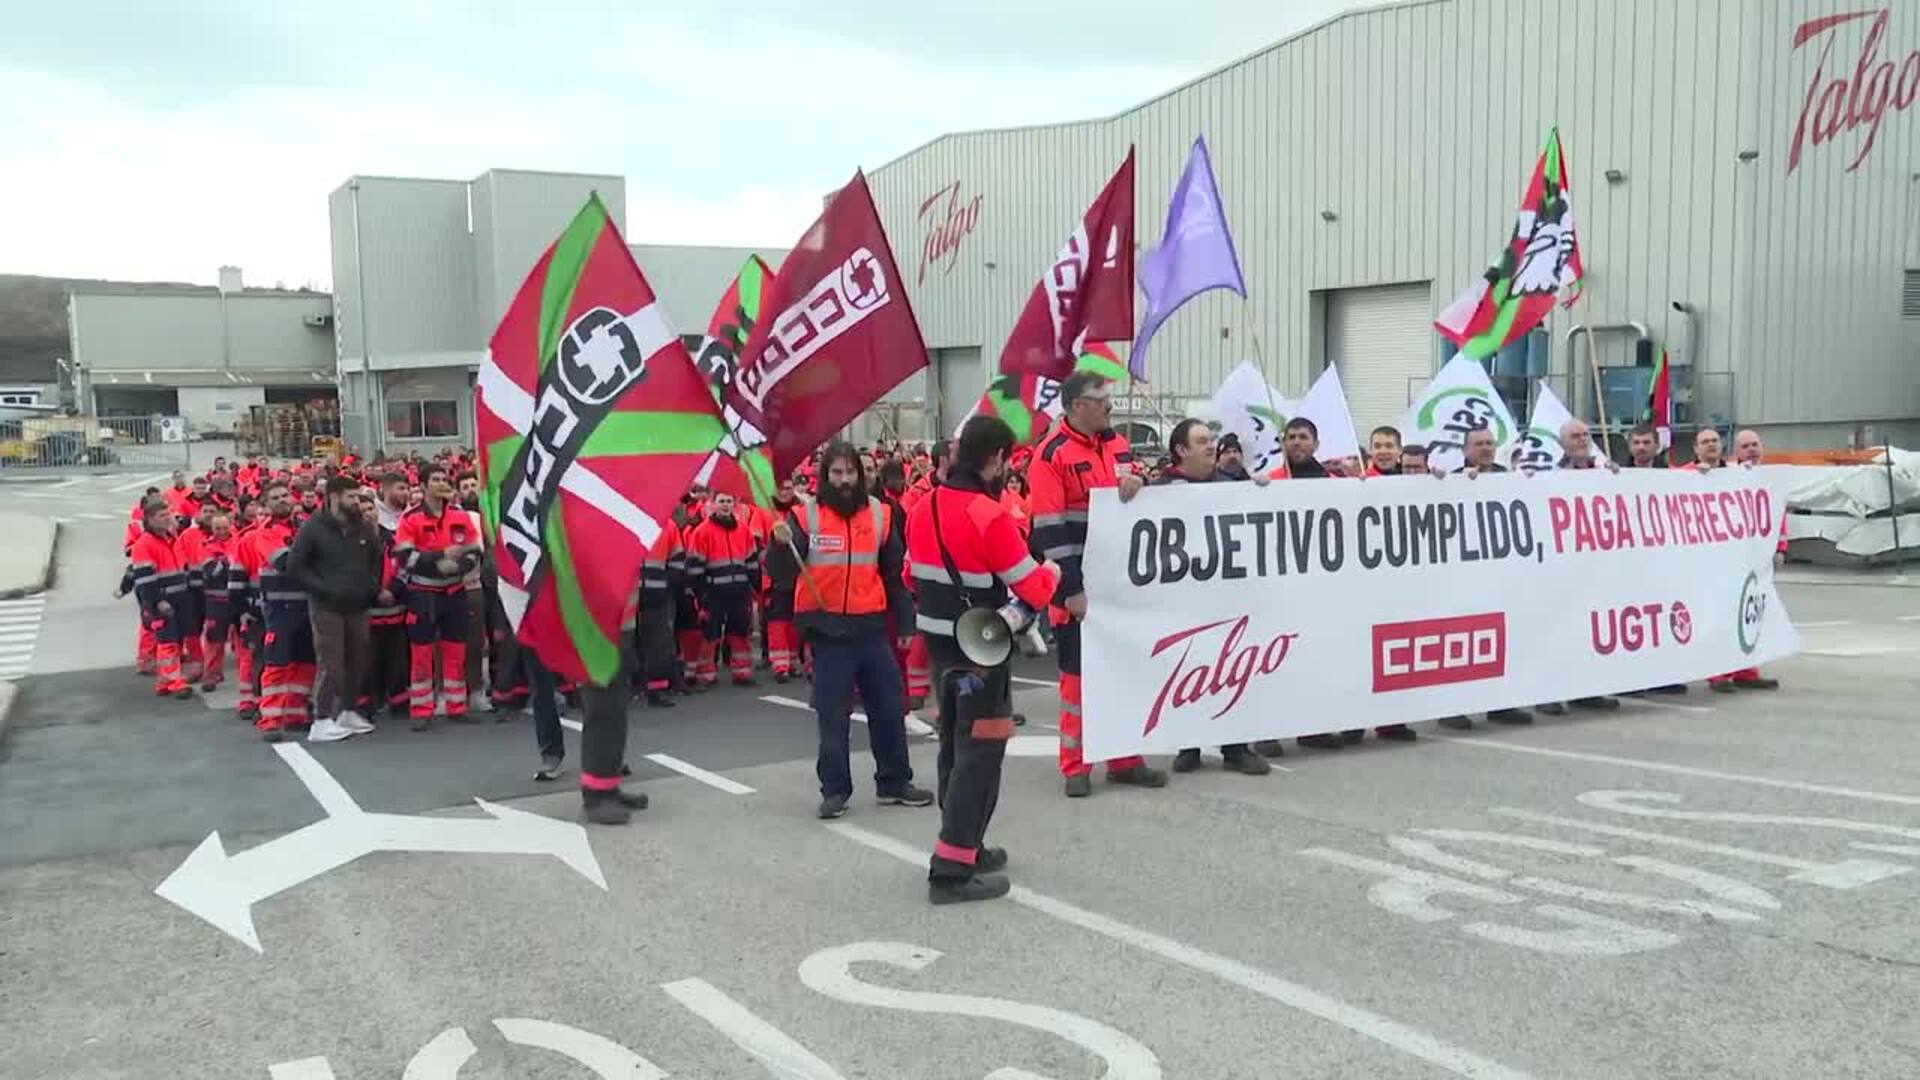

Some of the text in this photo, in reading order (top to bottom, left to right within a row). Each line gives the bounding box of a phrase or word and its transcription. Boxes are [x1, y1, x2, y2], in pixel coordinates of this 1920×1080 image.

[1788, 8, 1920, 176] Talgo
[918, 179, 983, 288] Talgo
[1128, 508, 1344, 587] OBJETIVO
[1357, 499, 1544, 569] CUMPLIDO,
[1549, 495, 1634, 554] PAGA
[1636, 492, 1666, 547] LO
[1142, 614, 1298, 737] Talgo
[1382, 628, 1497, 676] CCOO
[1590, 604, 1662, 655] UGT
